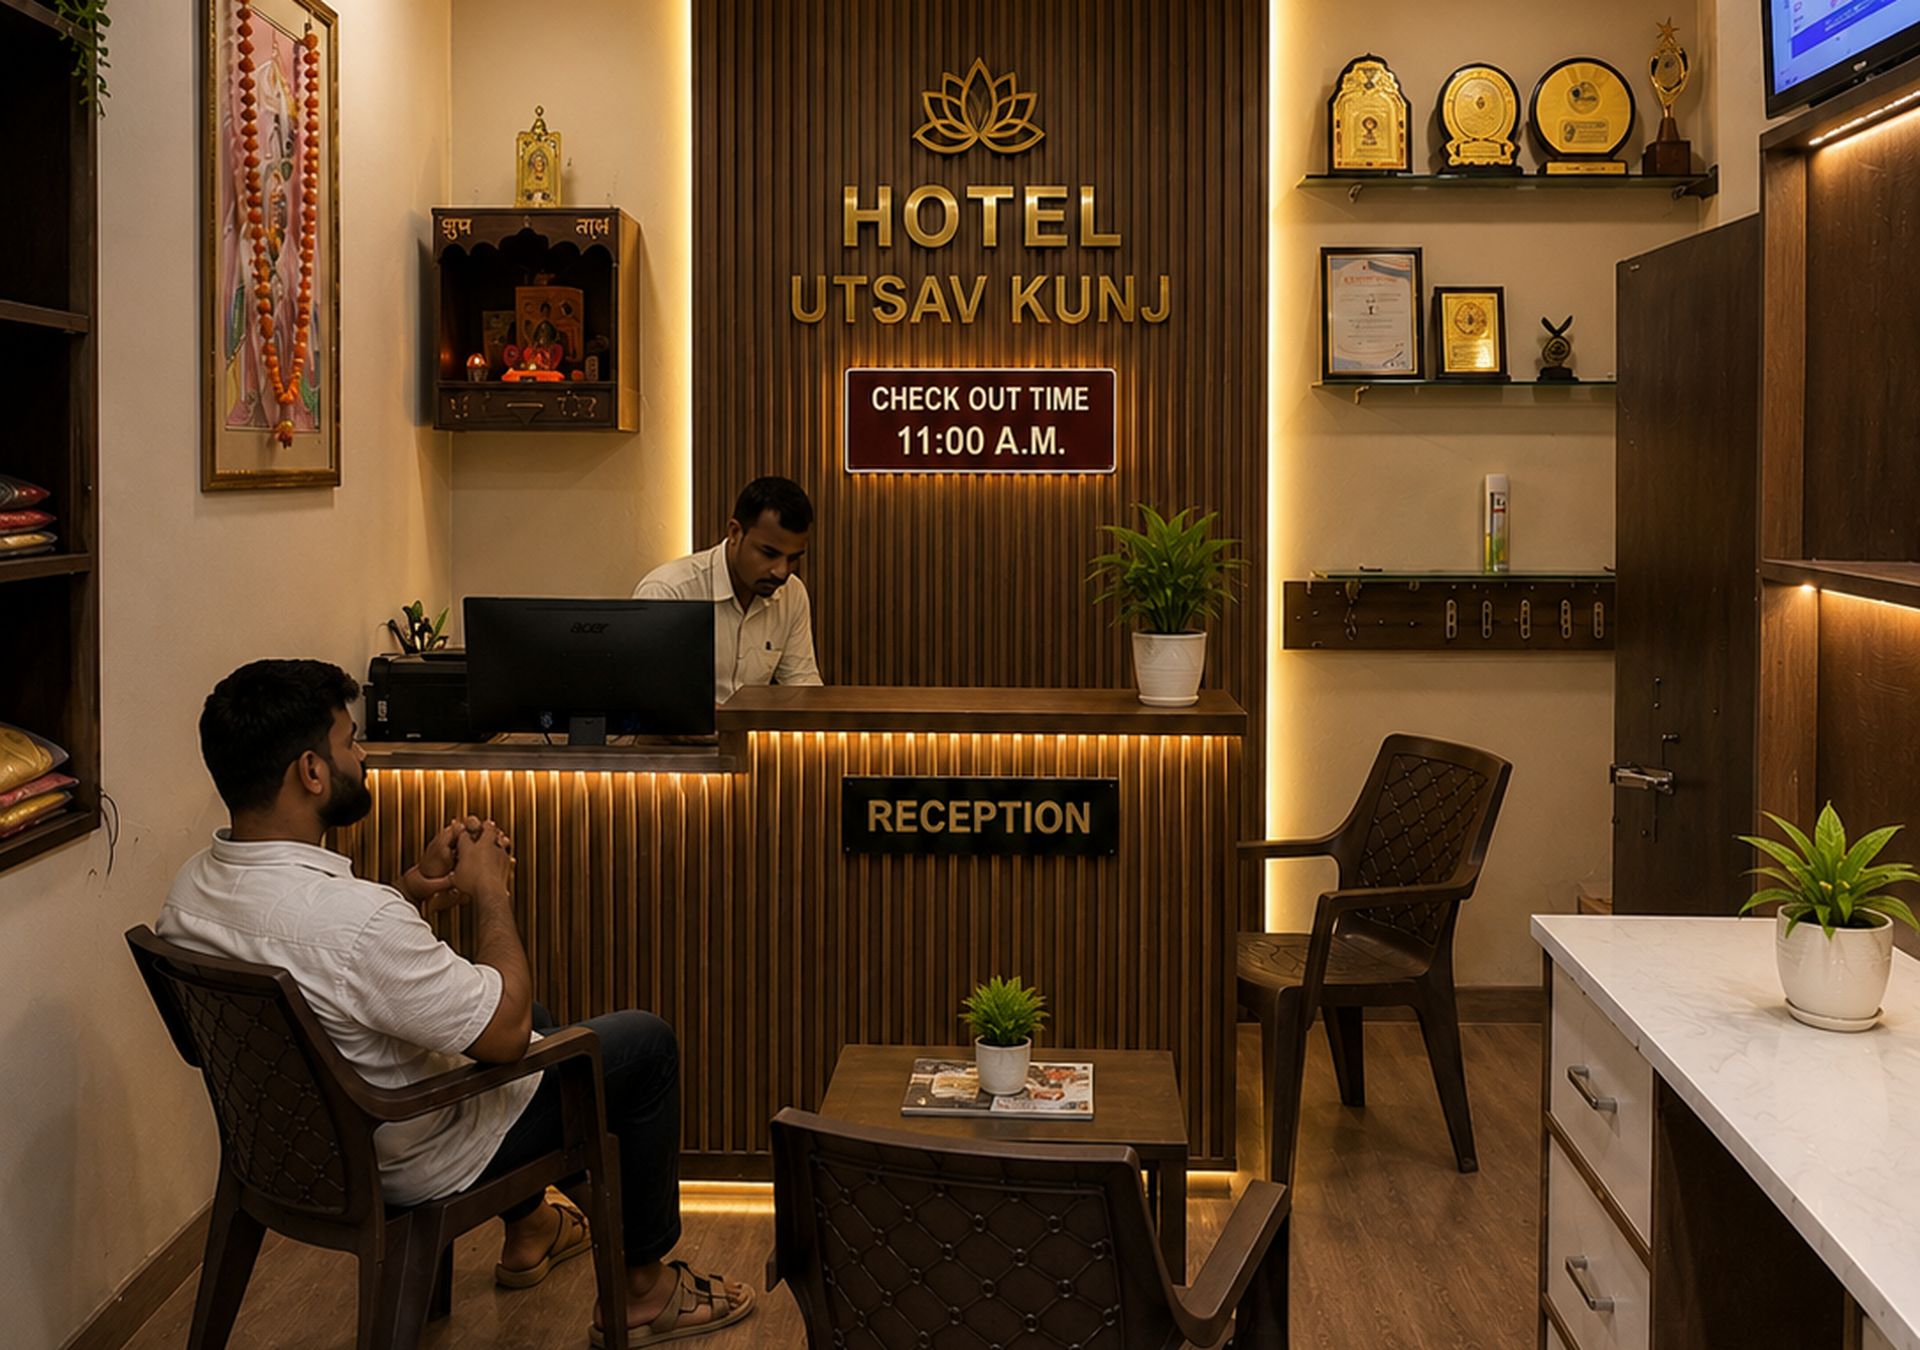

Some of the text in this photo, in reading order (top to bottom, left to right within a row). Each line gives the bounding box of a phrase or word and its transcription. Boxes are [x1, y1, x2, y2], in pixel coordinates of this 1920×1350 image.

[842, 184, 1122, 248] HOTEL
[790, 274, 1172, 325] UTSAV KUNJ
[871, 385, 1090, 411] CHECK OUT TIME
[897, 425, 1066, 456] 11:00 A.M.
[570, 622, 610, 634] acer
[867, 799, 1091, 834] RECEPTION
